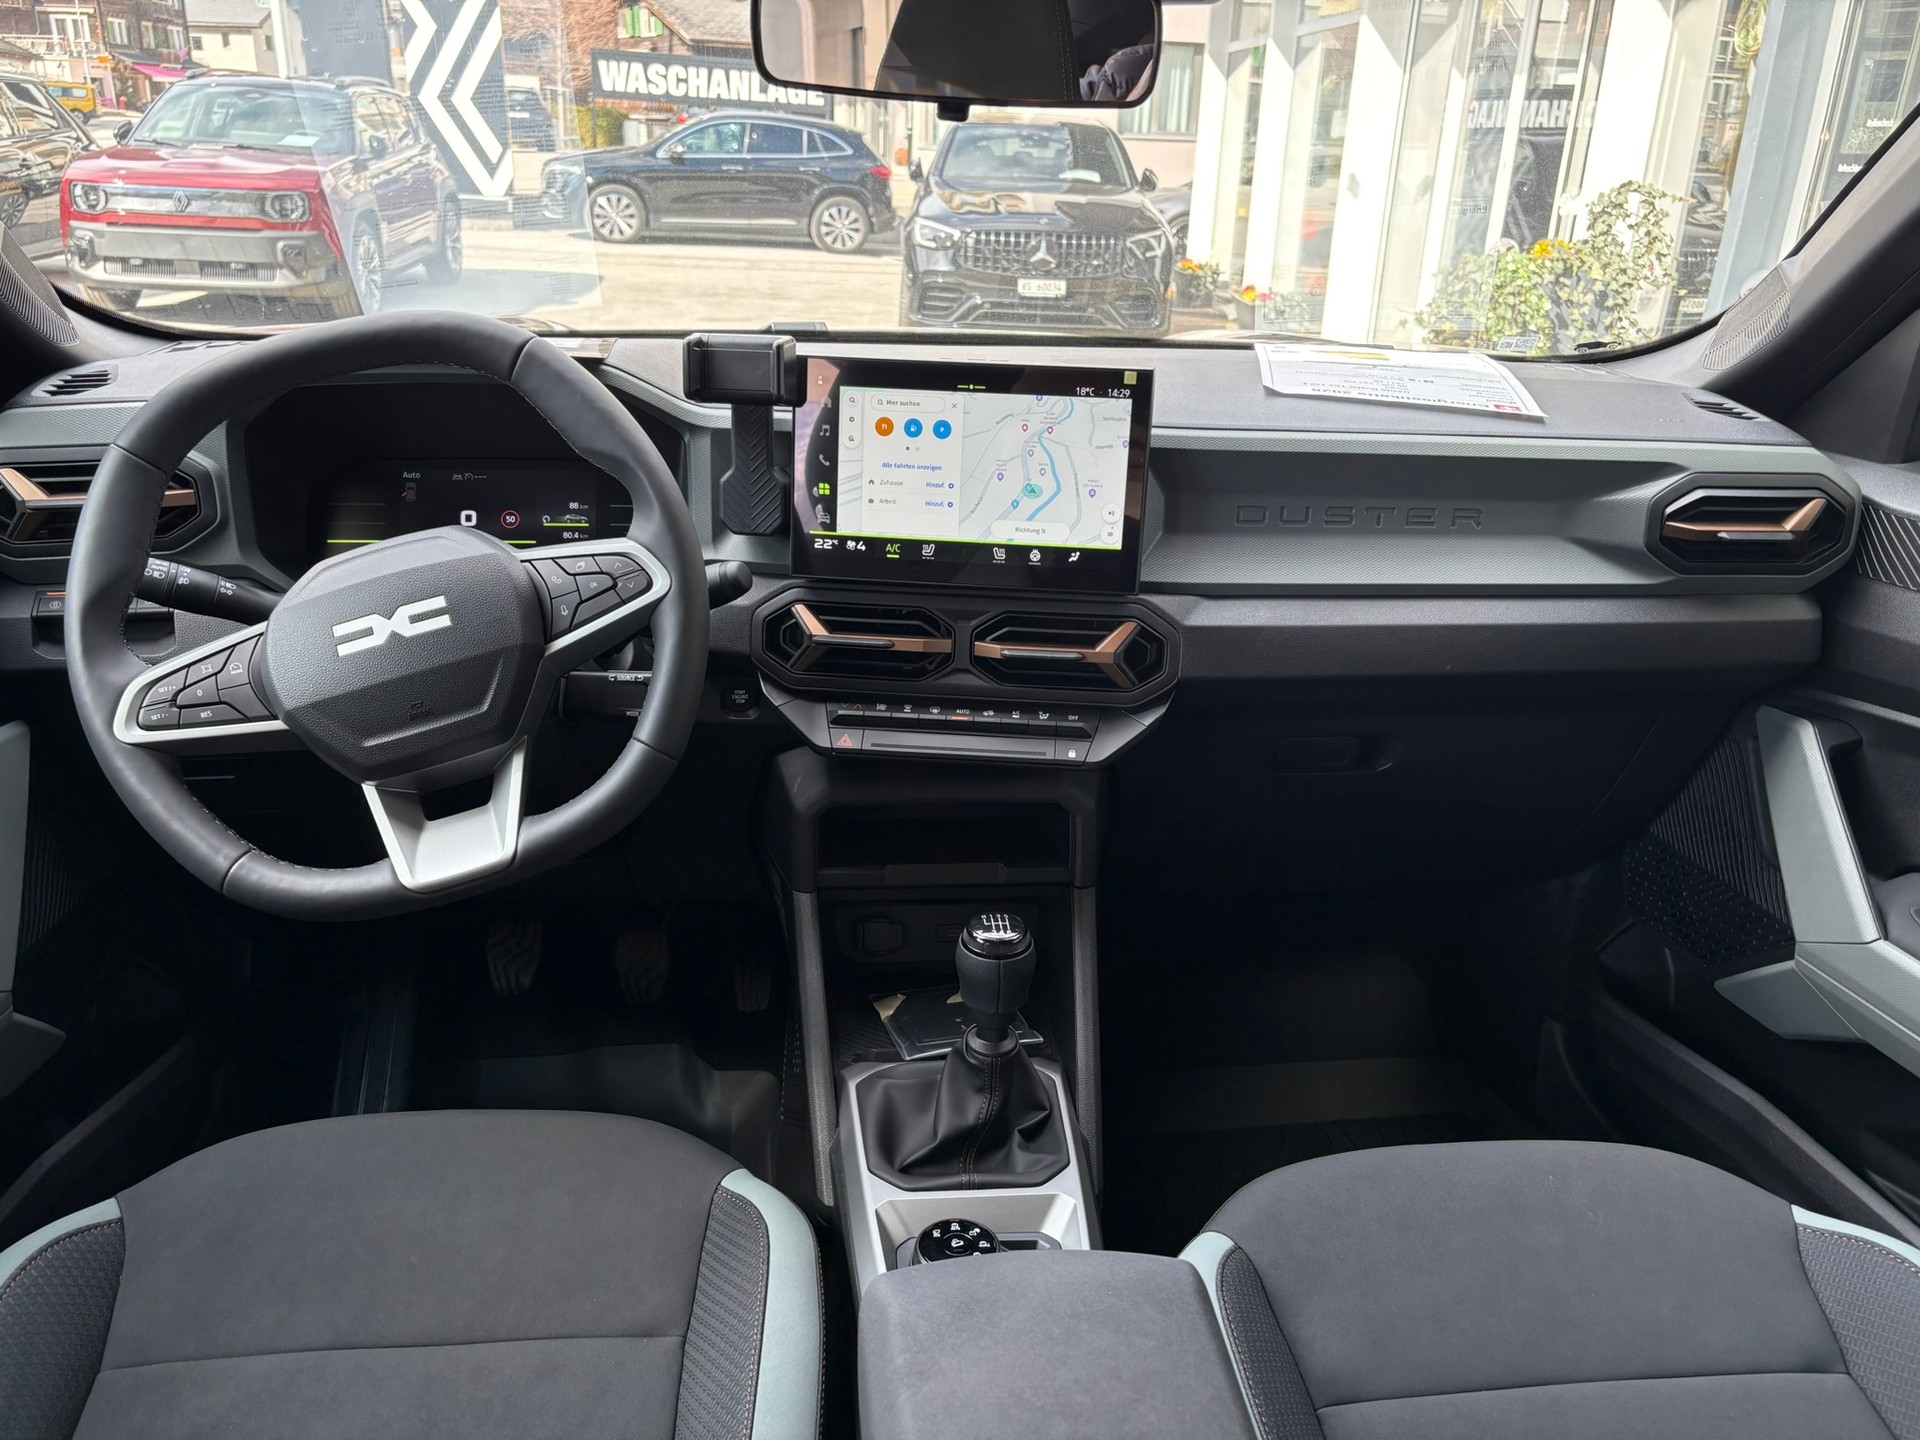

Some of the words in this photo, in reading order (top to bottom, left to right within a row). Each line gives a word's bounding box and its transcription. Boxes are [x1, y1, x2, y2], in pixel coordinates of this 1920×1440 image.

[1076, 387, 1095, 396] 18°C
[1108, 388, 1130, 398] 14:29
[569, 502, 579, 510] 88
[460, 510, 477, 527] 0
[505, 515, 516, 523] 50
[1234, 504, 1484, 529] DUSTER
[563, 531, 579, 540] 80.4
[1015, 527, 1041, 535] Richtung
[856, 541, 866, 551] 4
[886, 544, 900, 552] A/C
[589, 580, 599, 589] OK
[200, 710, 212, 718] RES
